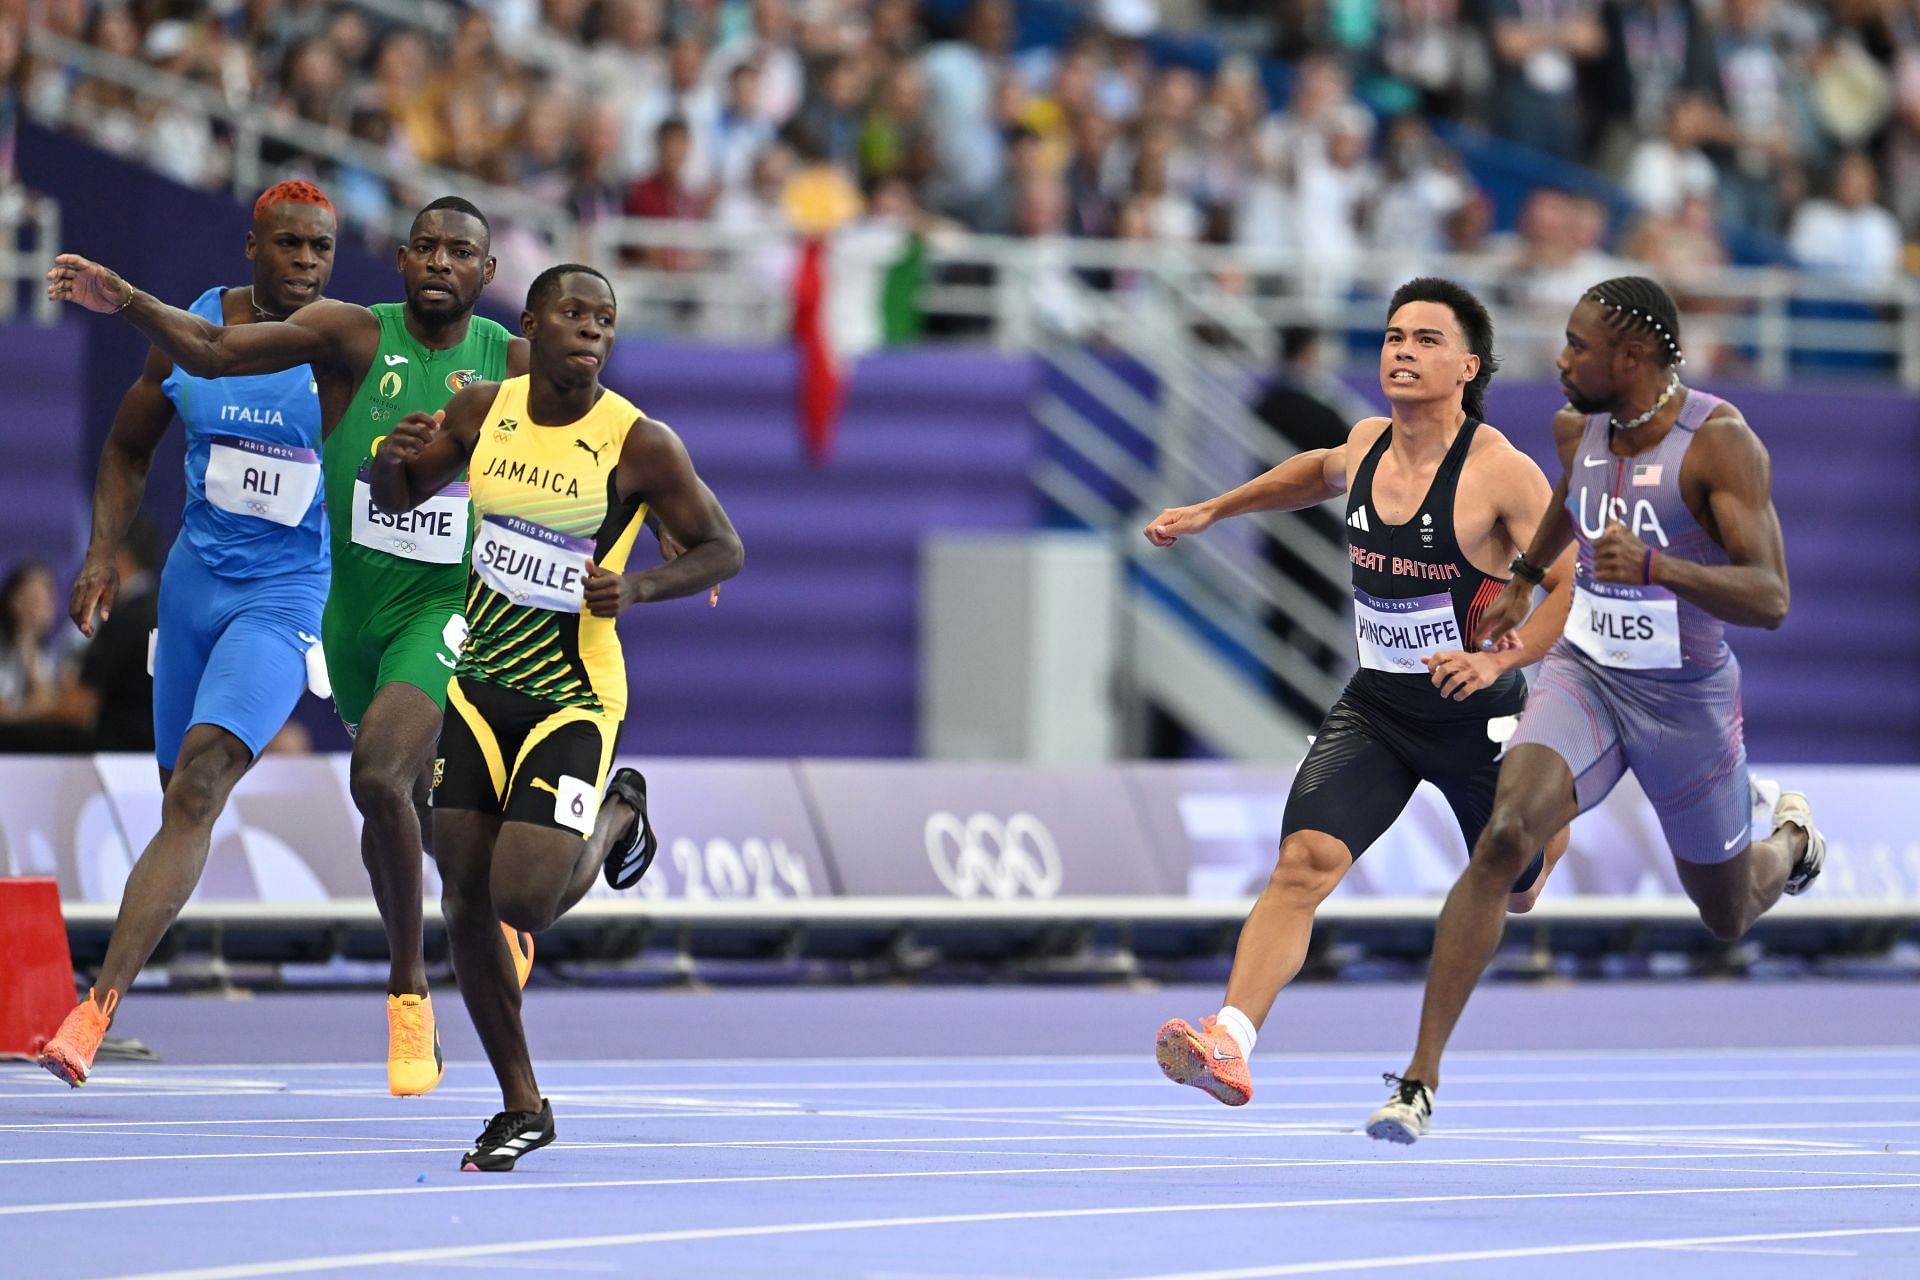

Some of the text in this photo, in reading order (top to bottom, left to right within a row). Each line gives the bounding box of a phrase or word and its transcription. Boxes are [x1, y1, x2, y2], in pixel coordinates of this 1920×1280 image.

[221, 404, 284, 427] ITALIA
[239, 440, 293, 458] PARIS 2024
[243, 467, 280, 496] ALI
[482, 457, 579, 499] JAMAICA
[507, 517, 566, 545] PARIS 2024
[1580, 486, 1669, 548] USA
[479, 539, 580, 593] SEVILLE
[1391, 556, 1462, 580] BRITAIN
[1367, 597, 1419, 610] PARIS 2024
[1358, 614, 1458, 650] HINCHLIFFE
[1591, 606, 1654, 641] LYLES
[571, 793, 584, 818] 6
[672, 837, 813, 899] 2024
